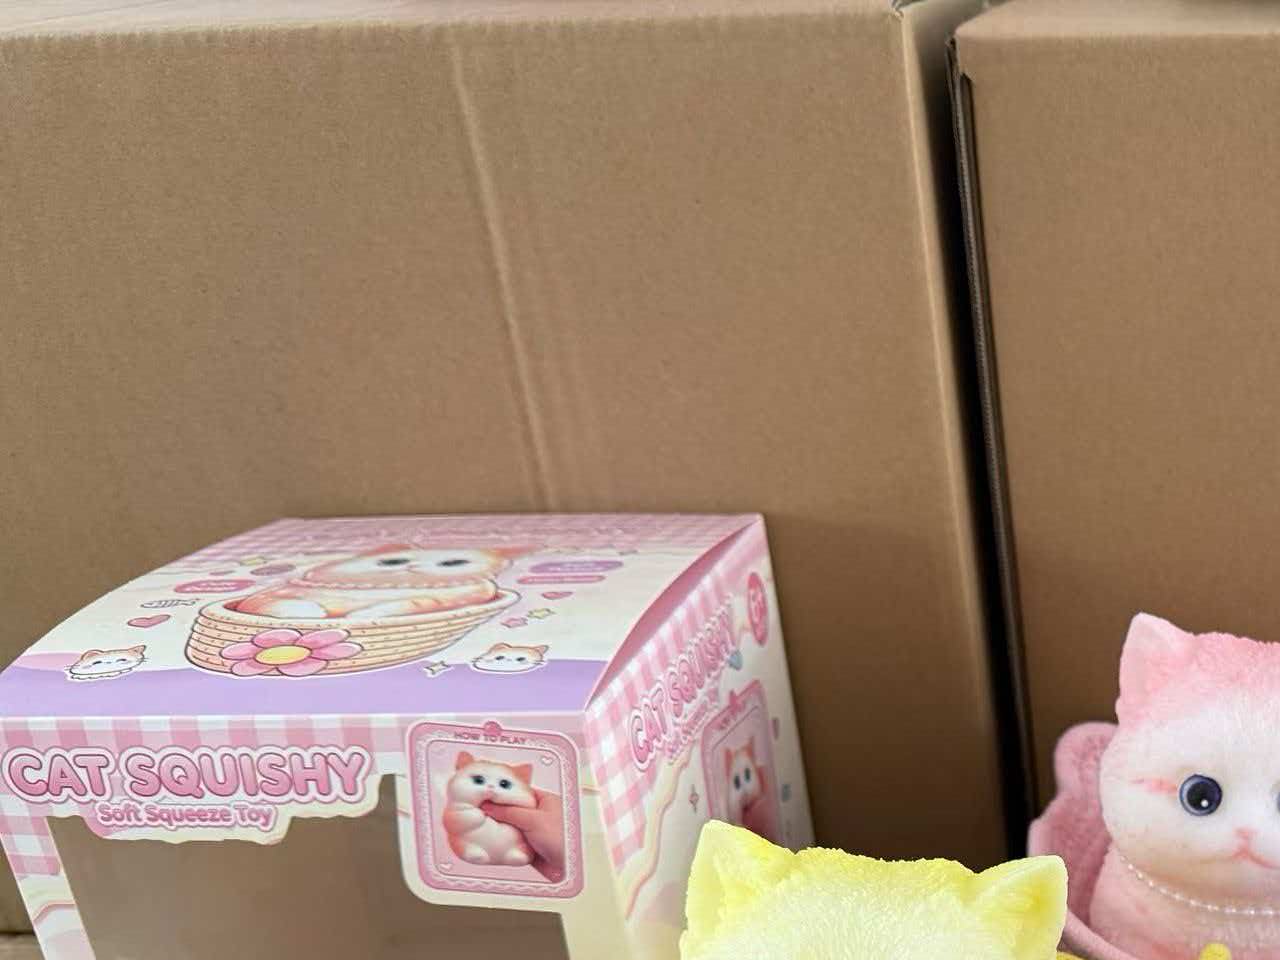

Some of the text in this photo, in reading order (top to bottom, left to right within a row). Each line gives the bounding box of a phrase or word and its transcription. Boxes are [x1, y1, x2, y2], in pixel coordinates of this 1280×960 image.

[454, 731, 527, 744] HOW TO PLAY
[631, 686, 667, 764] CAT
[8, 752, 364, 798] CAT SQUISHY
[100, 803, 273, 829] Soft Squeeze Toy
